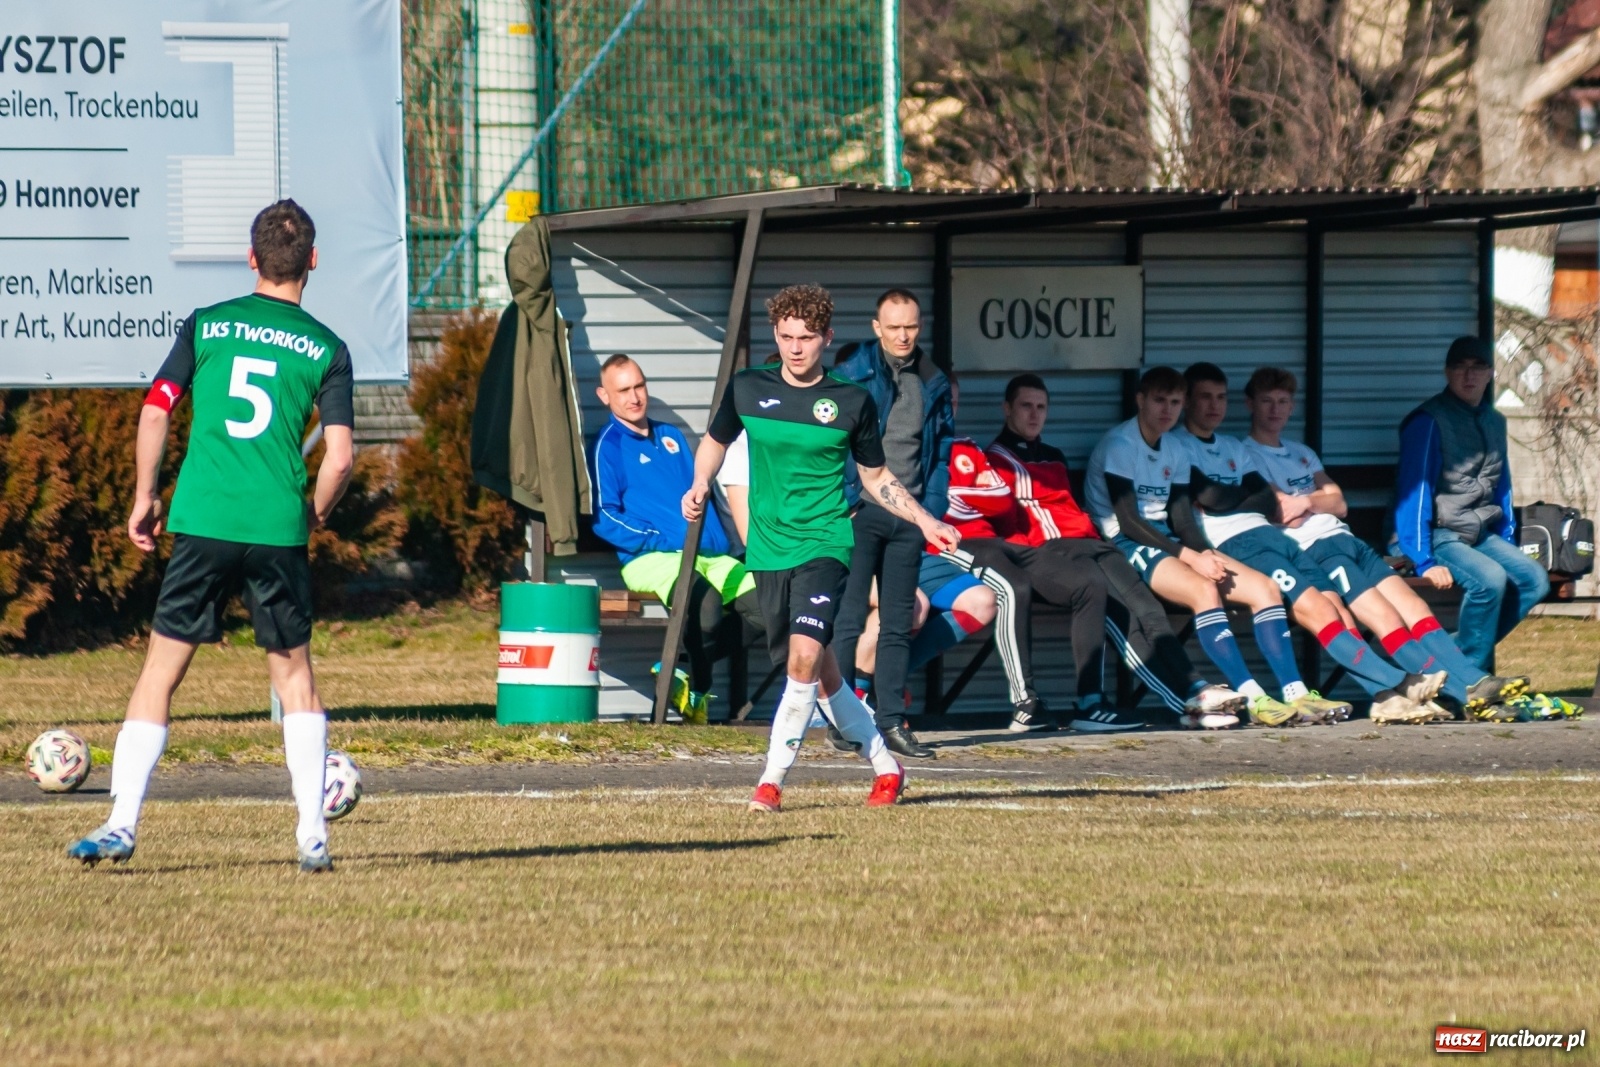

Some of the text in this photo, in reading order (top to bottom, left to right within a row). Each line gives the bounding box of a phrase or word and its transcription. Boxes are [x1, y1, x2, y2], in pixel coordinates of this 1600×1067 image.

[0, 89, 199, 121] eilen, Trockenbau
[16, 179, 140, 208] Hannover
[48, 268, 153, 295] Markisen
[15, 312, 55, 342] Art,
[979, 285, 1117, 340] GOŚCIE
[202, 322, 325, 361] LKS TWORKÓW
[224, 356, 277, 439] 5
[1271, 568, 1297, 592] 8
[1329, 565, 1351, 594] 7
